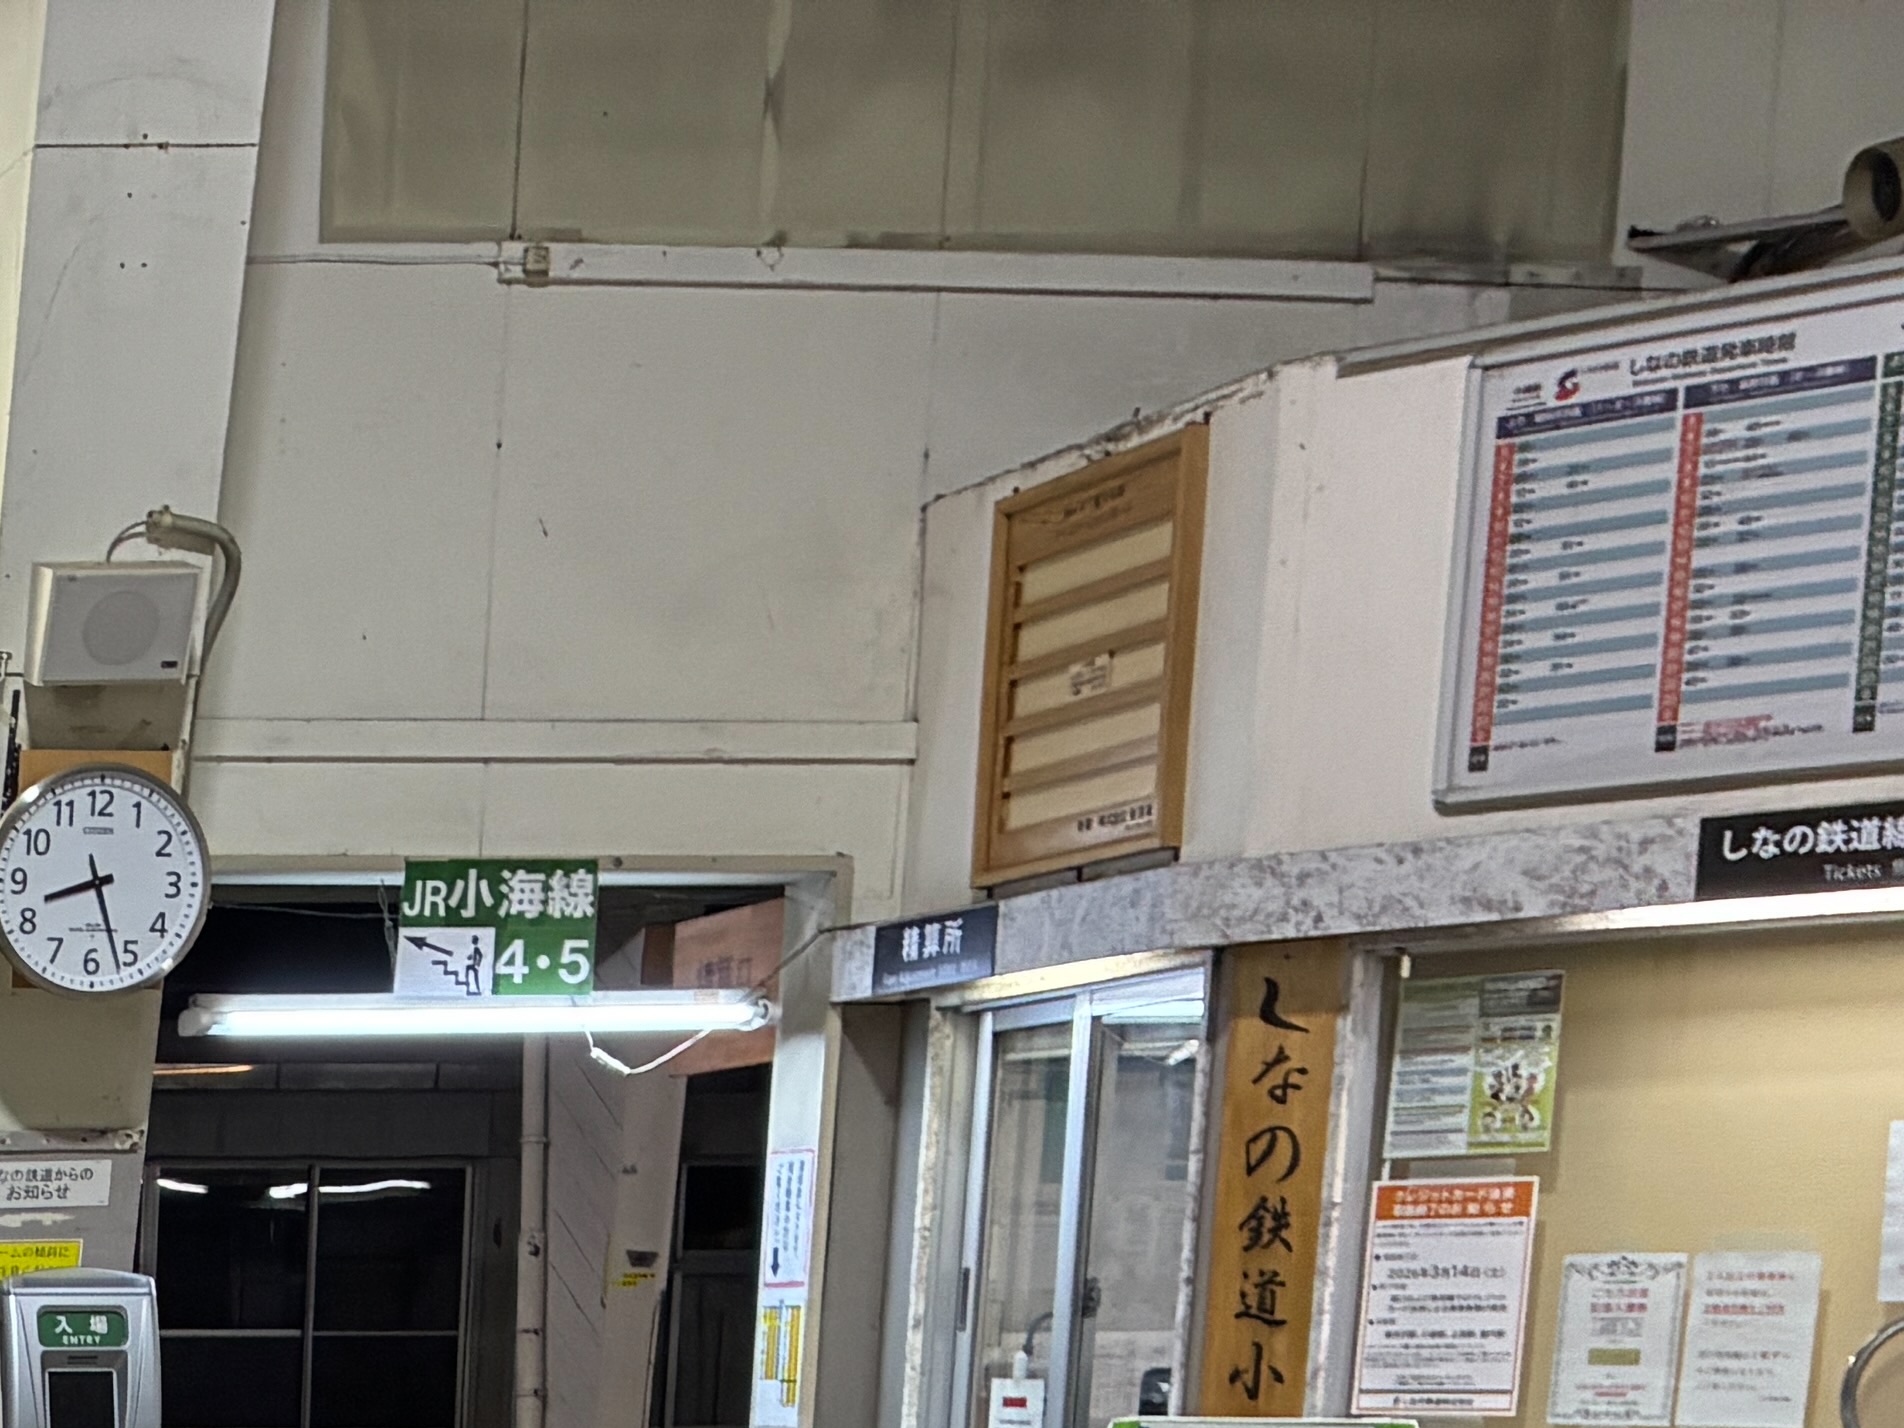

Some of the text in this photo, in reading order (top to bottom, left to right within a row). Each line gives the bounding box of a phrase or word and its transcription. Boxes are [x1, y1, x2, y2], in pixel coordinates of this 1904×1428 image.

[53, 800, 74, 827] 11
[87, 790, 114, 817] 12
[132, 801, 142, 828] 1
[22, 828, 51, 855] 10
[155, 830, 173, 857] 2
[11, 868, 27, 894] 9
[165, 871, 182, 898] 3
[404, 868, 595, 918] JR小海線
[19, 908, 36, 934] 8
[150, 912, 168, 938] 4
[47, 937, 64, 963] 7
[83, 948, 100, 975] 6
[123, 940, 139, 967] 5
[496, 939, 590, 984] 4・5
[6, 1184, 70, 1201] お知らせ
[54, 1315, 109, 1335] 入場
[62, 1334, 101, 1345] ENTRY
